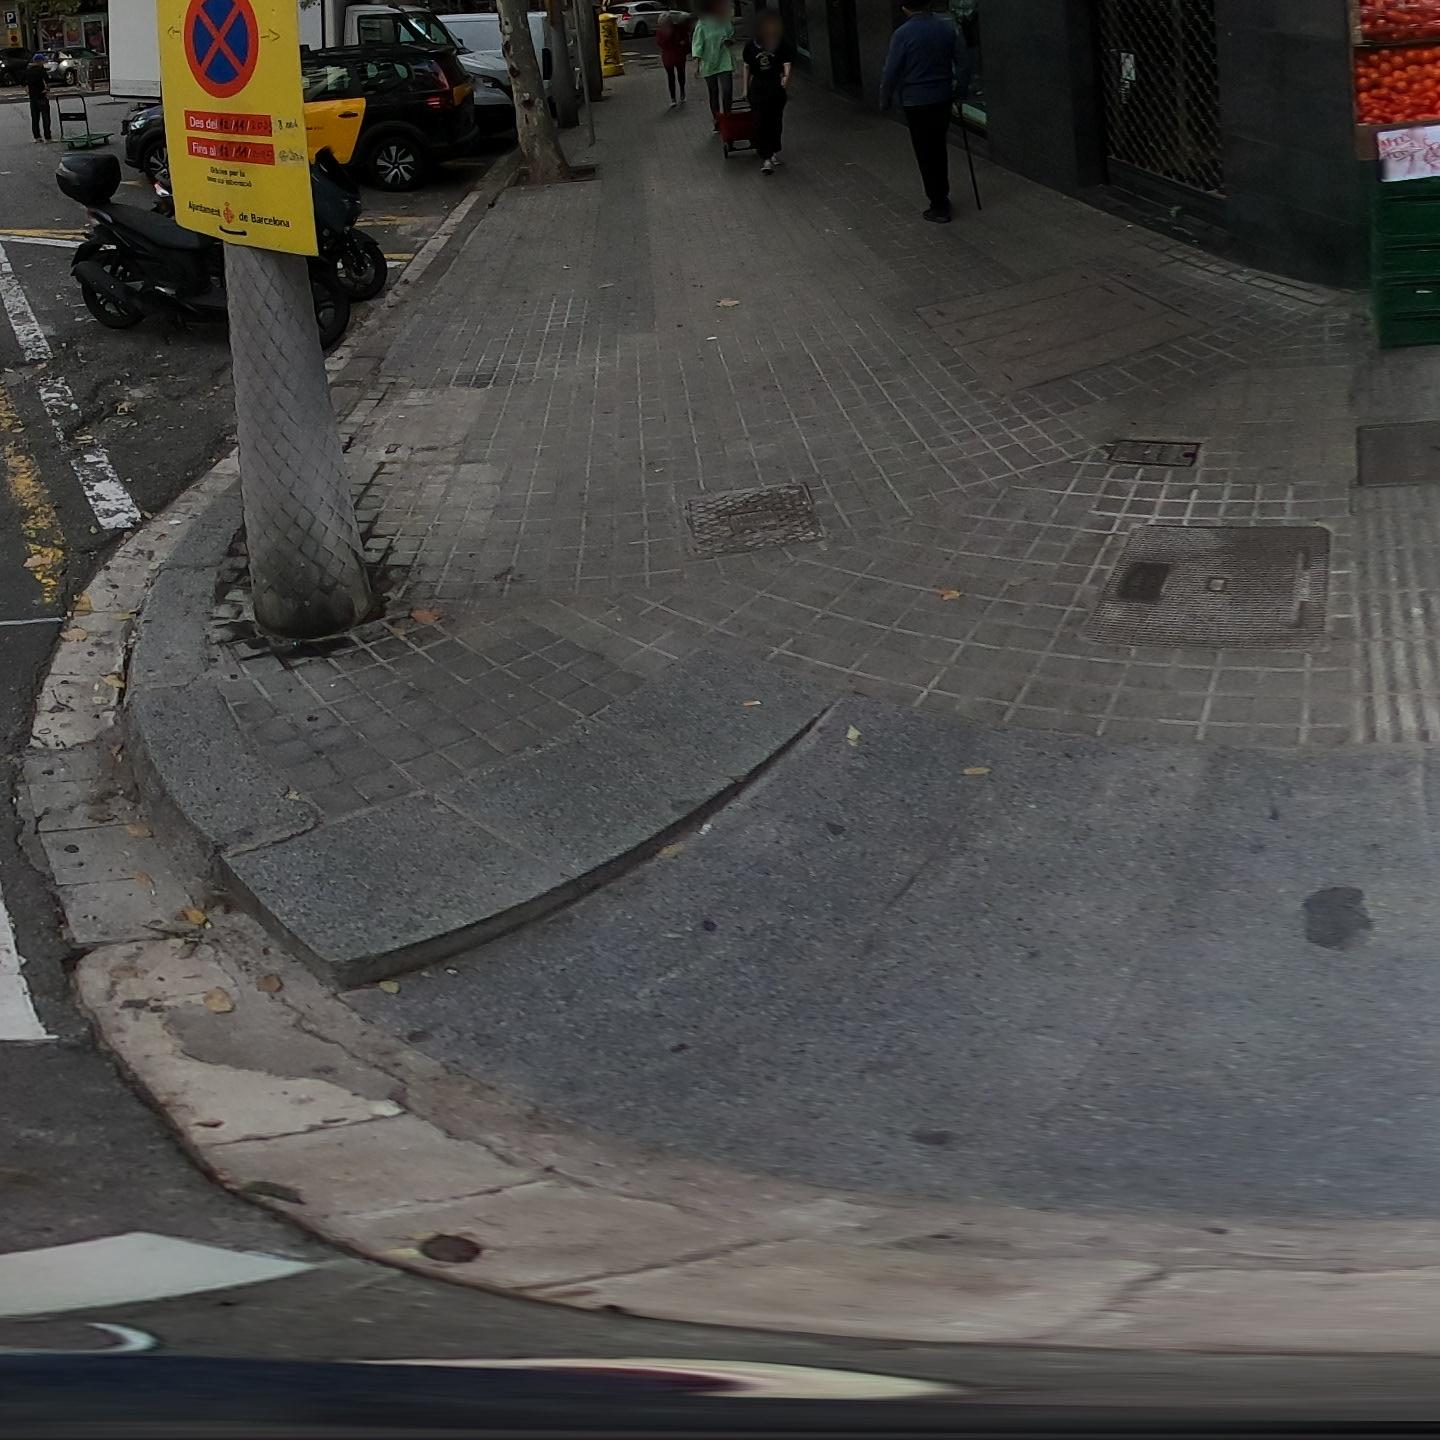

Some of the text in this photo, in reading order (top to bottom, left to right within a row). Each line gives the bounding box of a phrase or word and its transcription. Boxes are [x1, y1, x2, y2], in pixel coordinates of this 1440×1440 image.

[189, 115, 205, 129] Des
[238, 211, 249, 223] de
[250, 212, 291, 228] Barcelona
